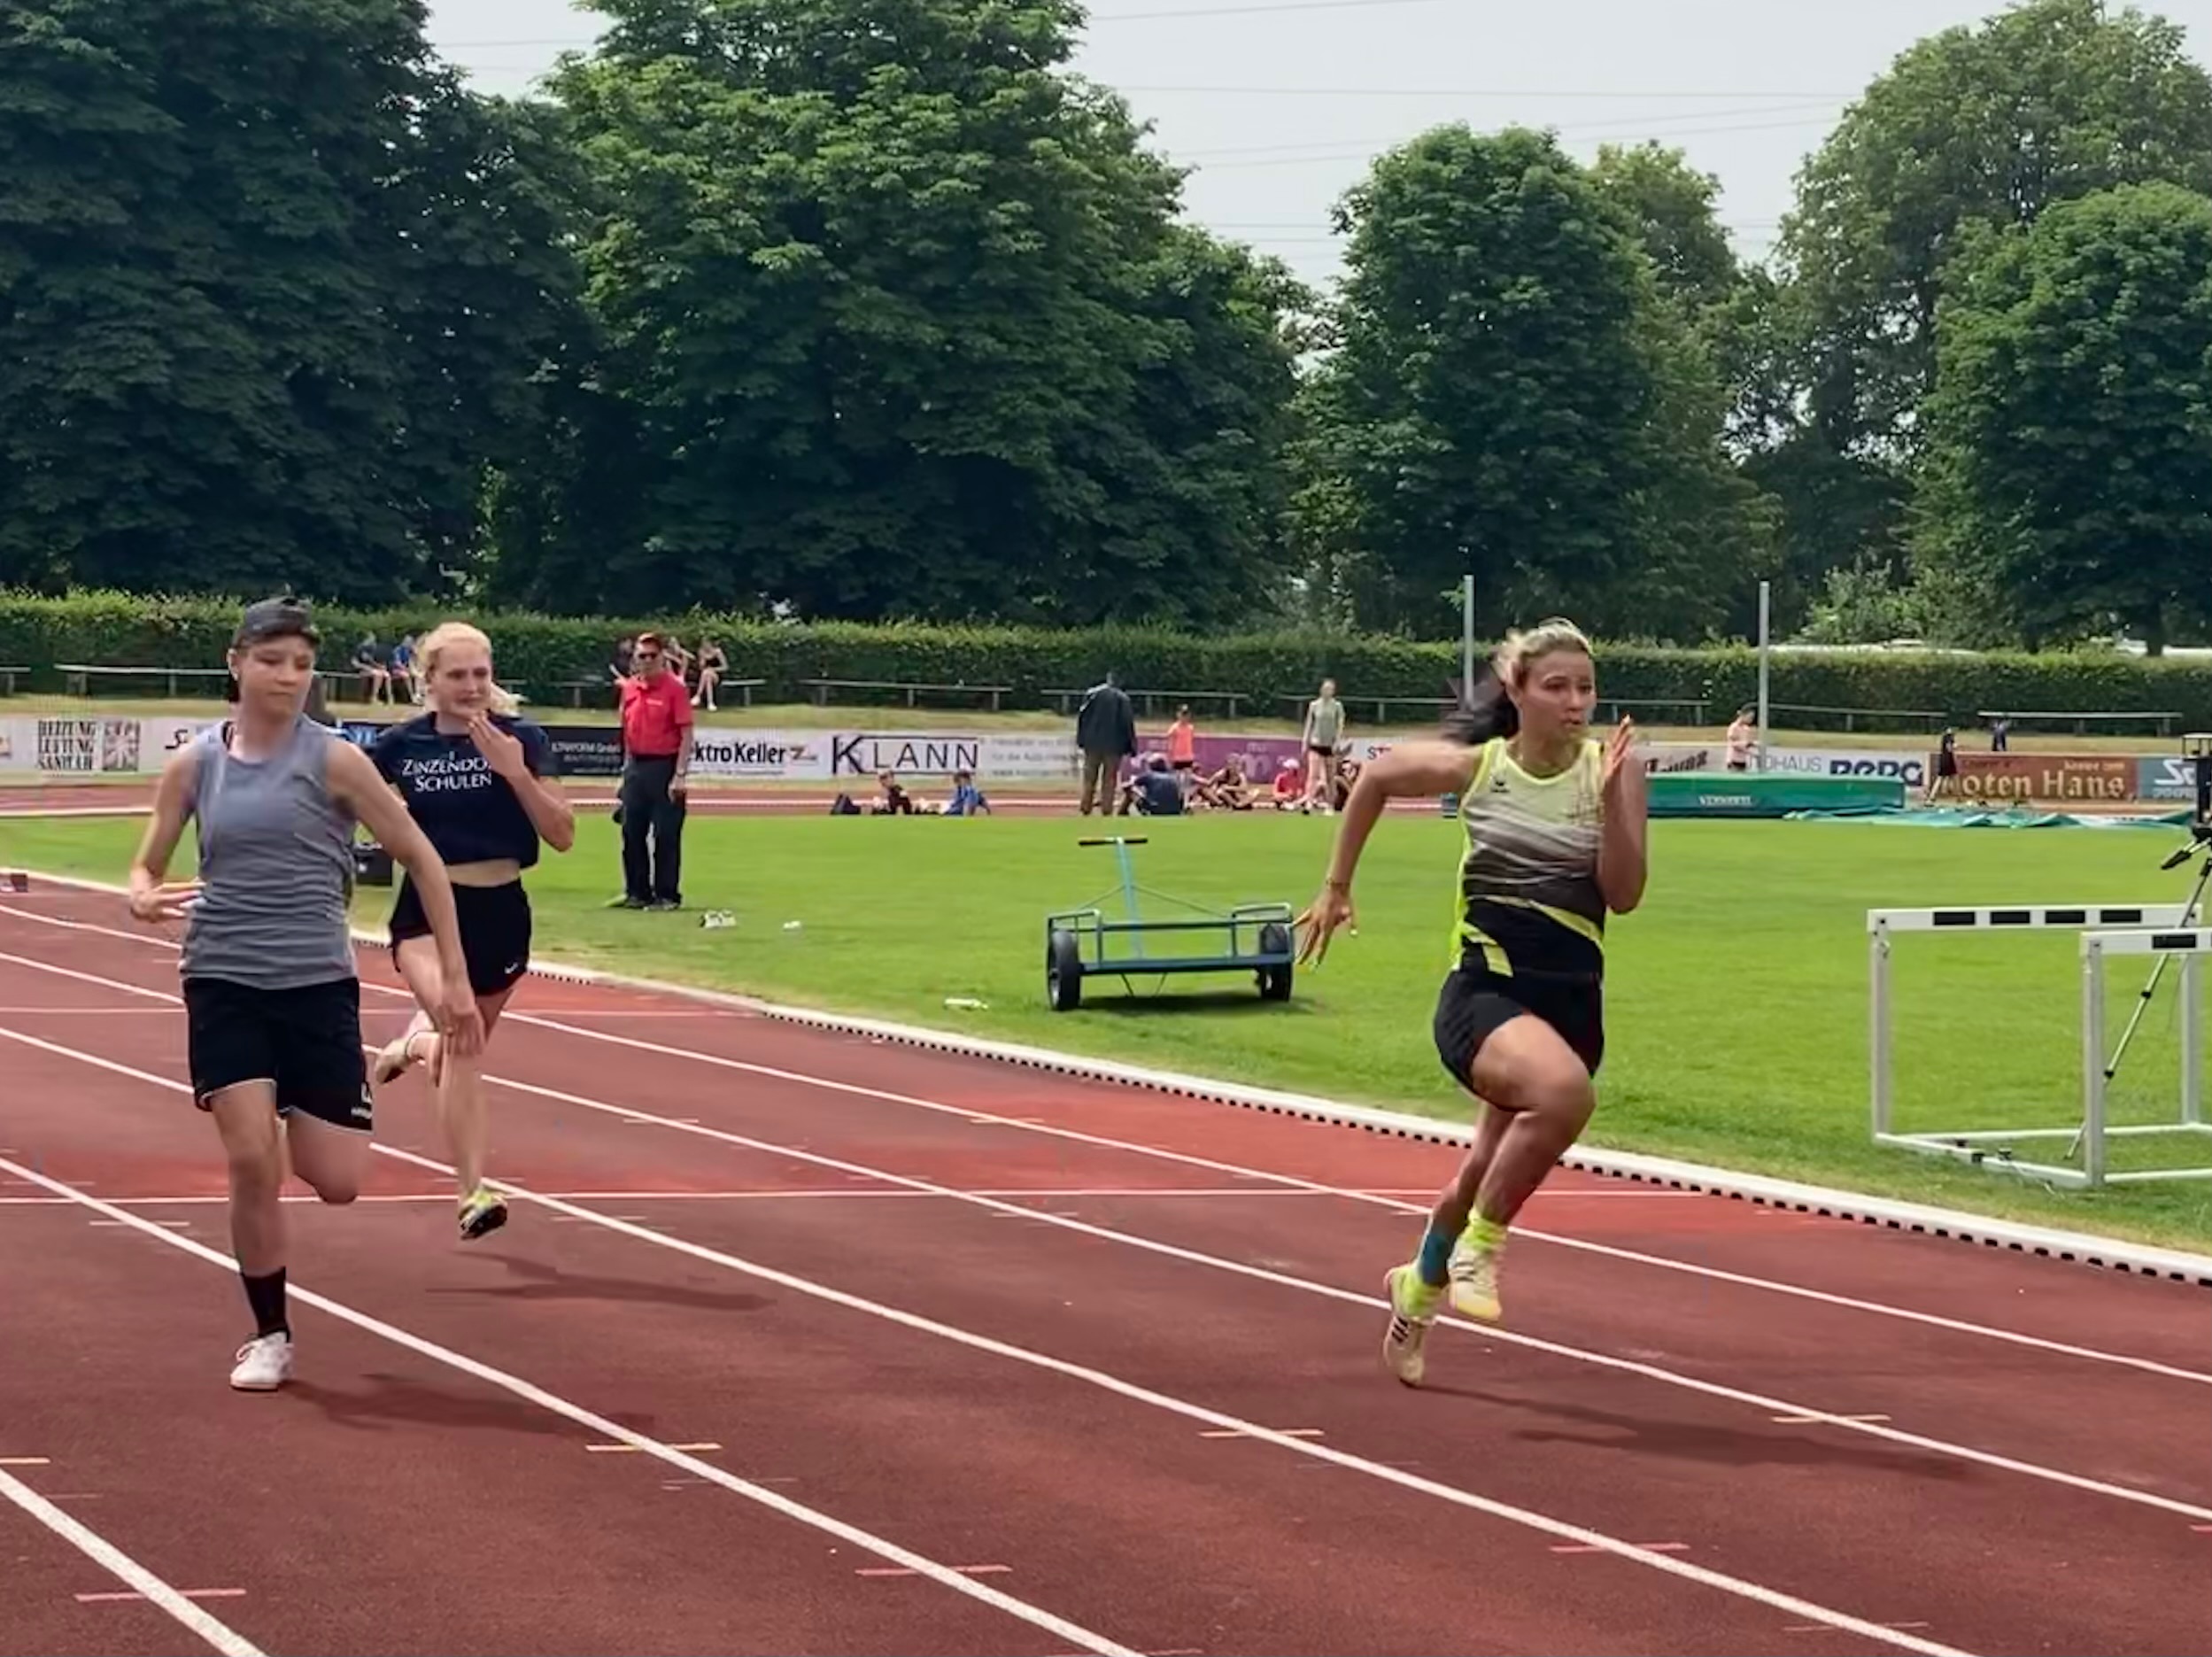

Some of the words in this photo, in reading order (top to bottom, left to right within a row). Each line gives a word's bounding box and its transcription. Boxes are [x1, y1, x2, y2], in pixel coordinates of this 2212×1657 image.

[402, 756, 491, 778] ZINZENDO
[832, 735, 978, 775] KLANN
[414, 772, 492, 793] SCHULEN
[2043, 769, 2125, 800] Hans
